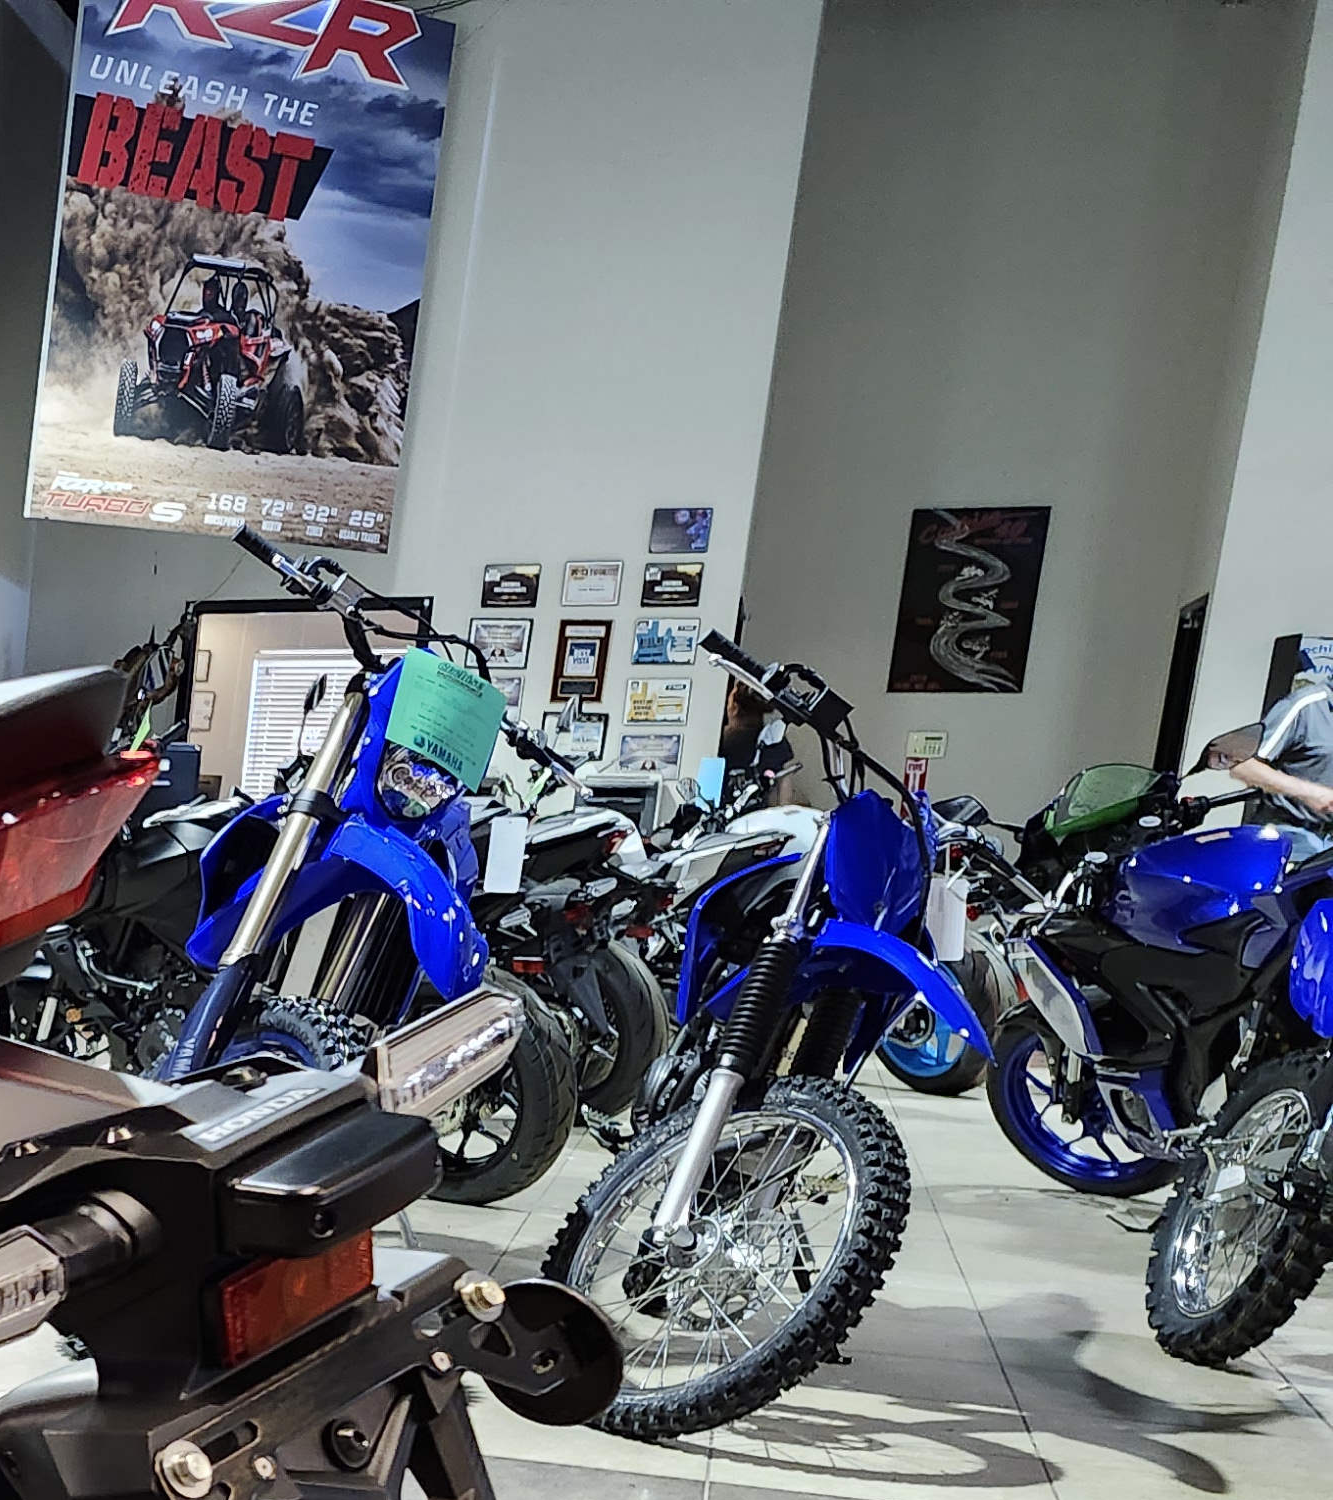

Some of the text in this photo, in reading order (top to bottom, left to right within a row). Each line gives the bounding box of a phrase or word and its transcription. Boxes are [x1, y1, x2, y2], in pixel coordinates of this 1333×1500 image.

[90, 54, 320, 127] UNLEASH THE
[77, 92, 315, 222] BEAST
[43, 490, 152, 518] TURBO
[206, 492, 384, 529] 168 72" 32" 25"
[426, 739, 464, 774] YAMAHA
[196, 1086, 324, 1142] HONDA
